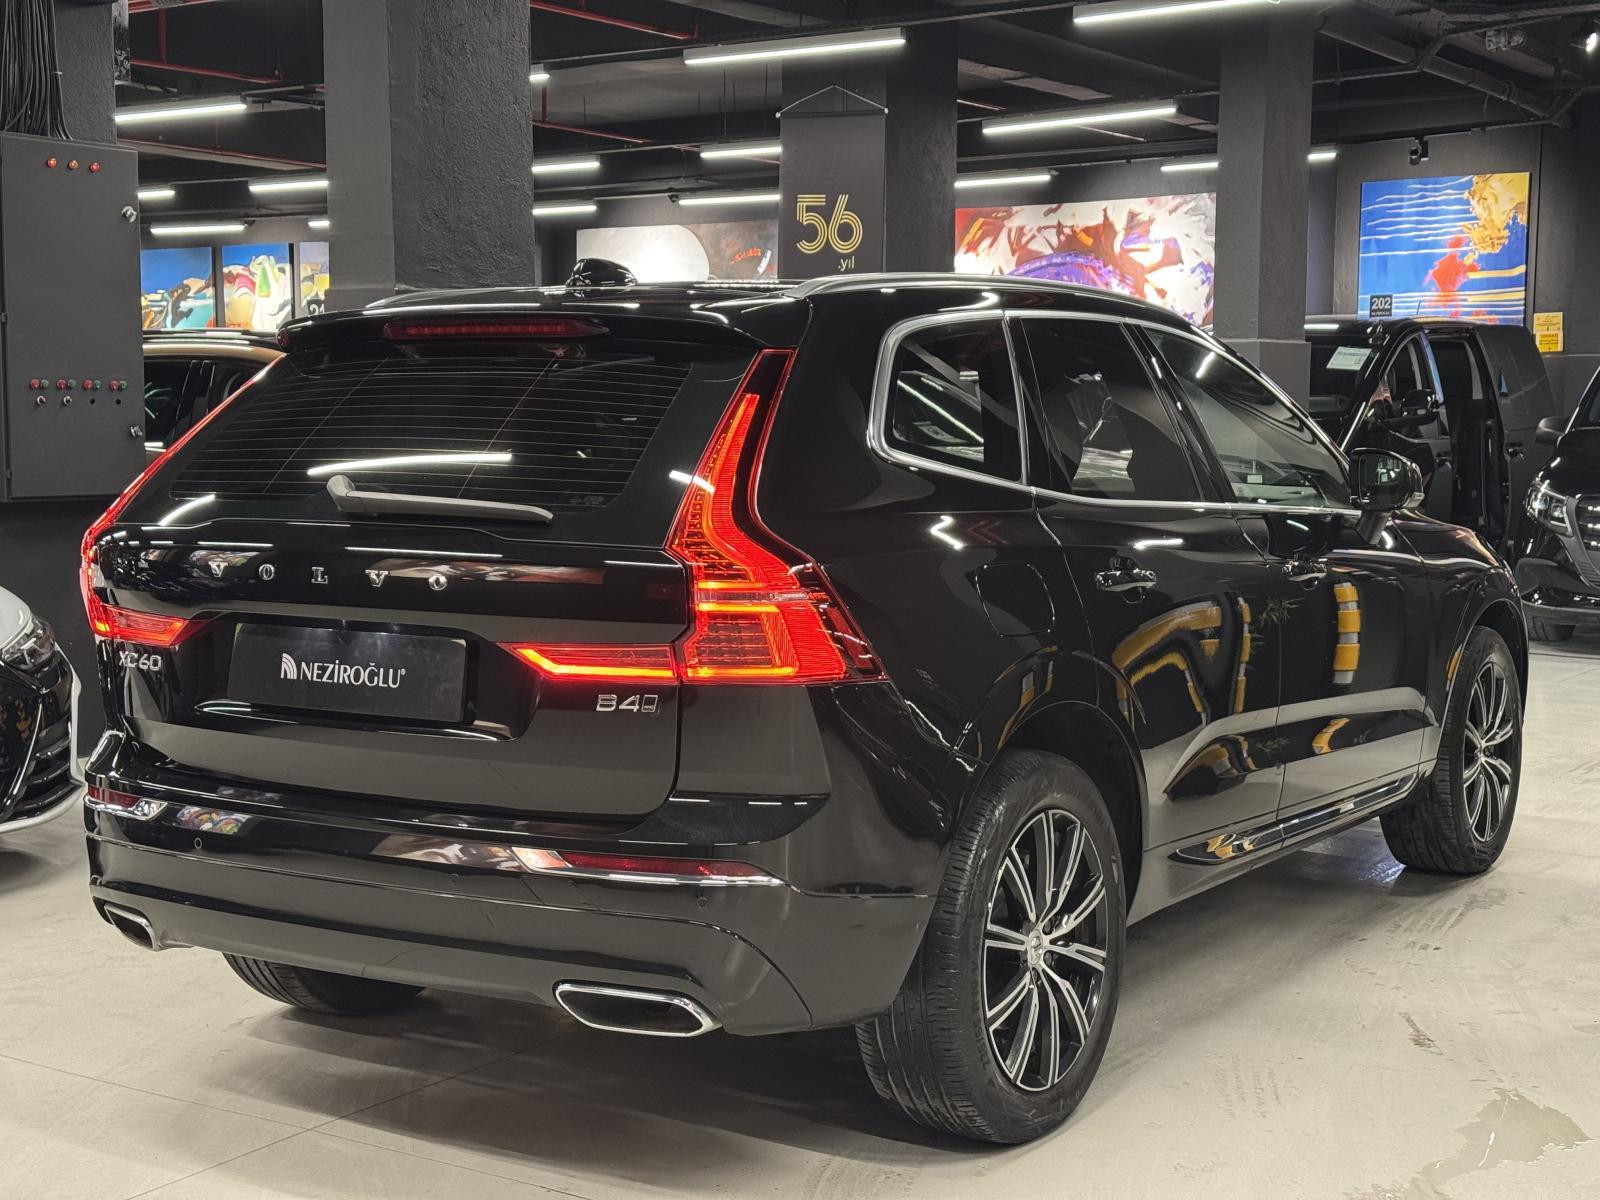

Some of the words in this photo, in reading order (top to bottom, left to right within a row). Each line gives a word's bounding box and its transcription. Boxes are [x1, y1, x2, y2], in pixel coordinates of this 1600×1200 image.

[796, 194, 863, 254] 56
[1371, 297, 1391, 310] 202
[207, 560, 448, 591] VOLVO
[119, 650, 162, 671] XC60
[596, 694, 640, 713] B4
